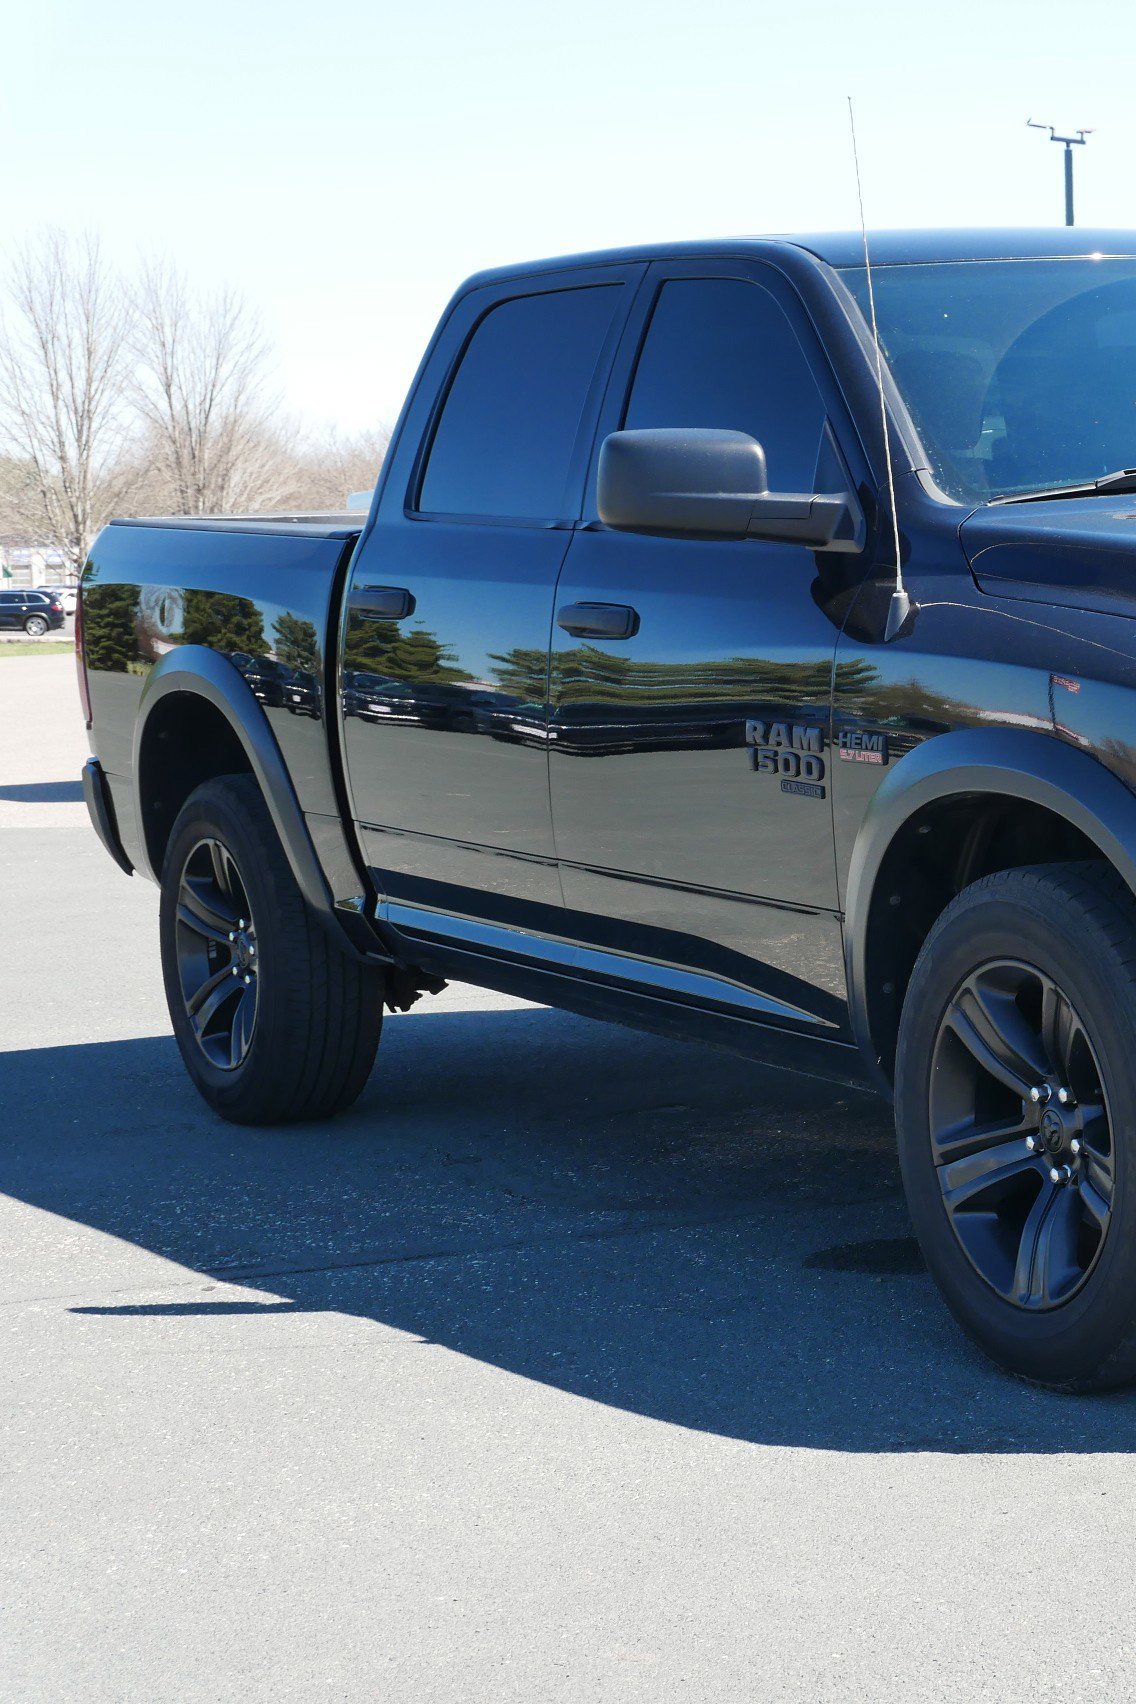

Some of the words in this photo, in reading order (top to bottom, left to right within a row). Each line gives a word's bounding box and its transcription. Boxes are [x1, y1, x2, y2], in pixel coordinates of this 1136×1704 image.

[745, 719, 824, 752] RAM
[838, 731, 884, 751] HEMI
[744, 747, 825, 781] 1500
[855, 750, 882, 763] LITER
[781, 781, 822, 798] CLASSIC
